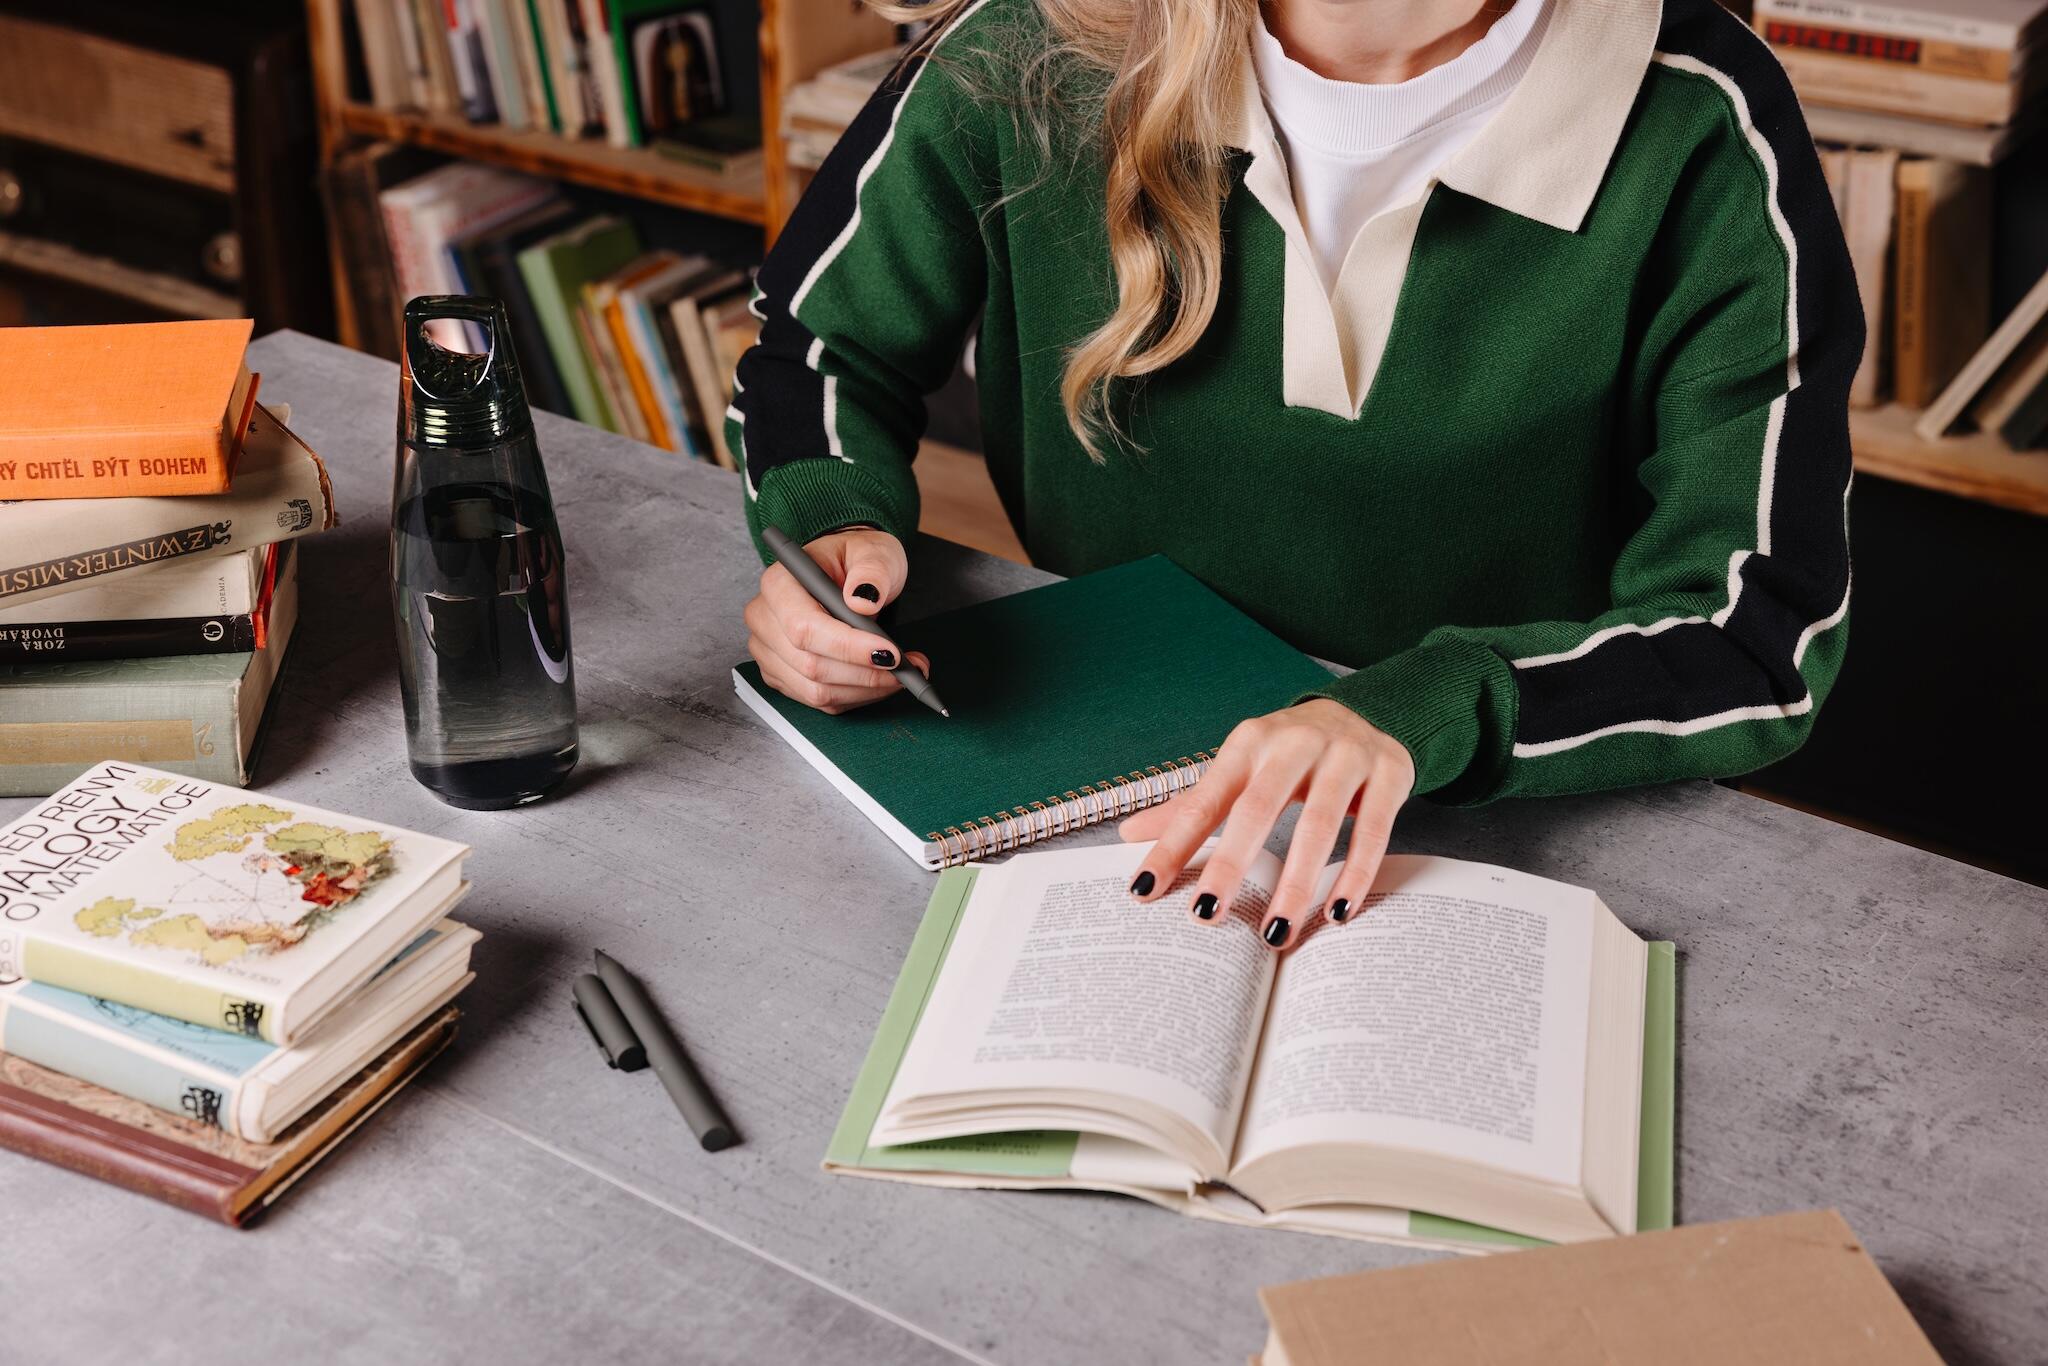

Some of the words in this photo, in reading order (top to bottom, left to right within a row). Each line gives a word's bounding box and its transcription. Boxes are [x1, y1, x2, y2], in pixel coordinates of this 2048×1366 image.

[26, 458, 84, 480] CHTĚL
[92, 457, 129, 478] BÝT
[139, 457, 207, 477] BOHEM
[219, 576, 228, 617] CADEMIA
[21, 639, 65, 650] ZORA
[38, 765, 136, 822] RENYI
[0, 796, 139, 910] IALOGY
[5, 902, 40, 921] O
[31, 783, 211, 900] MATEMATICE
